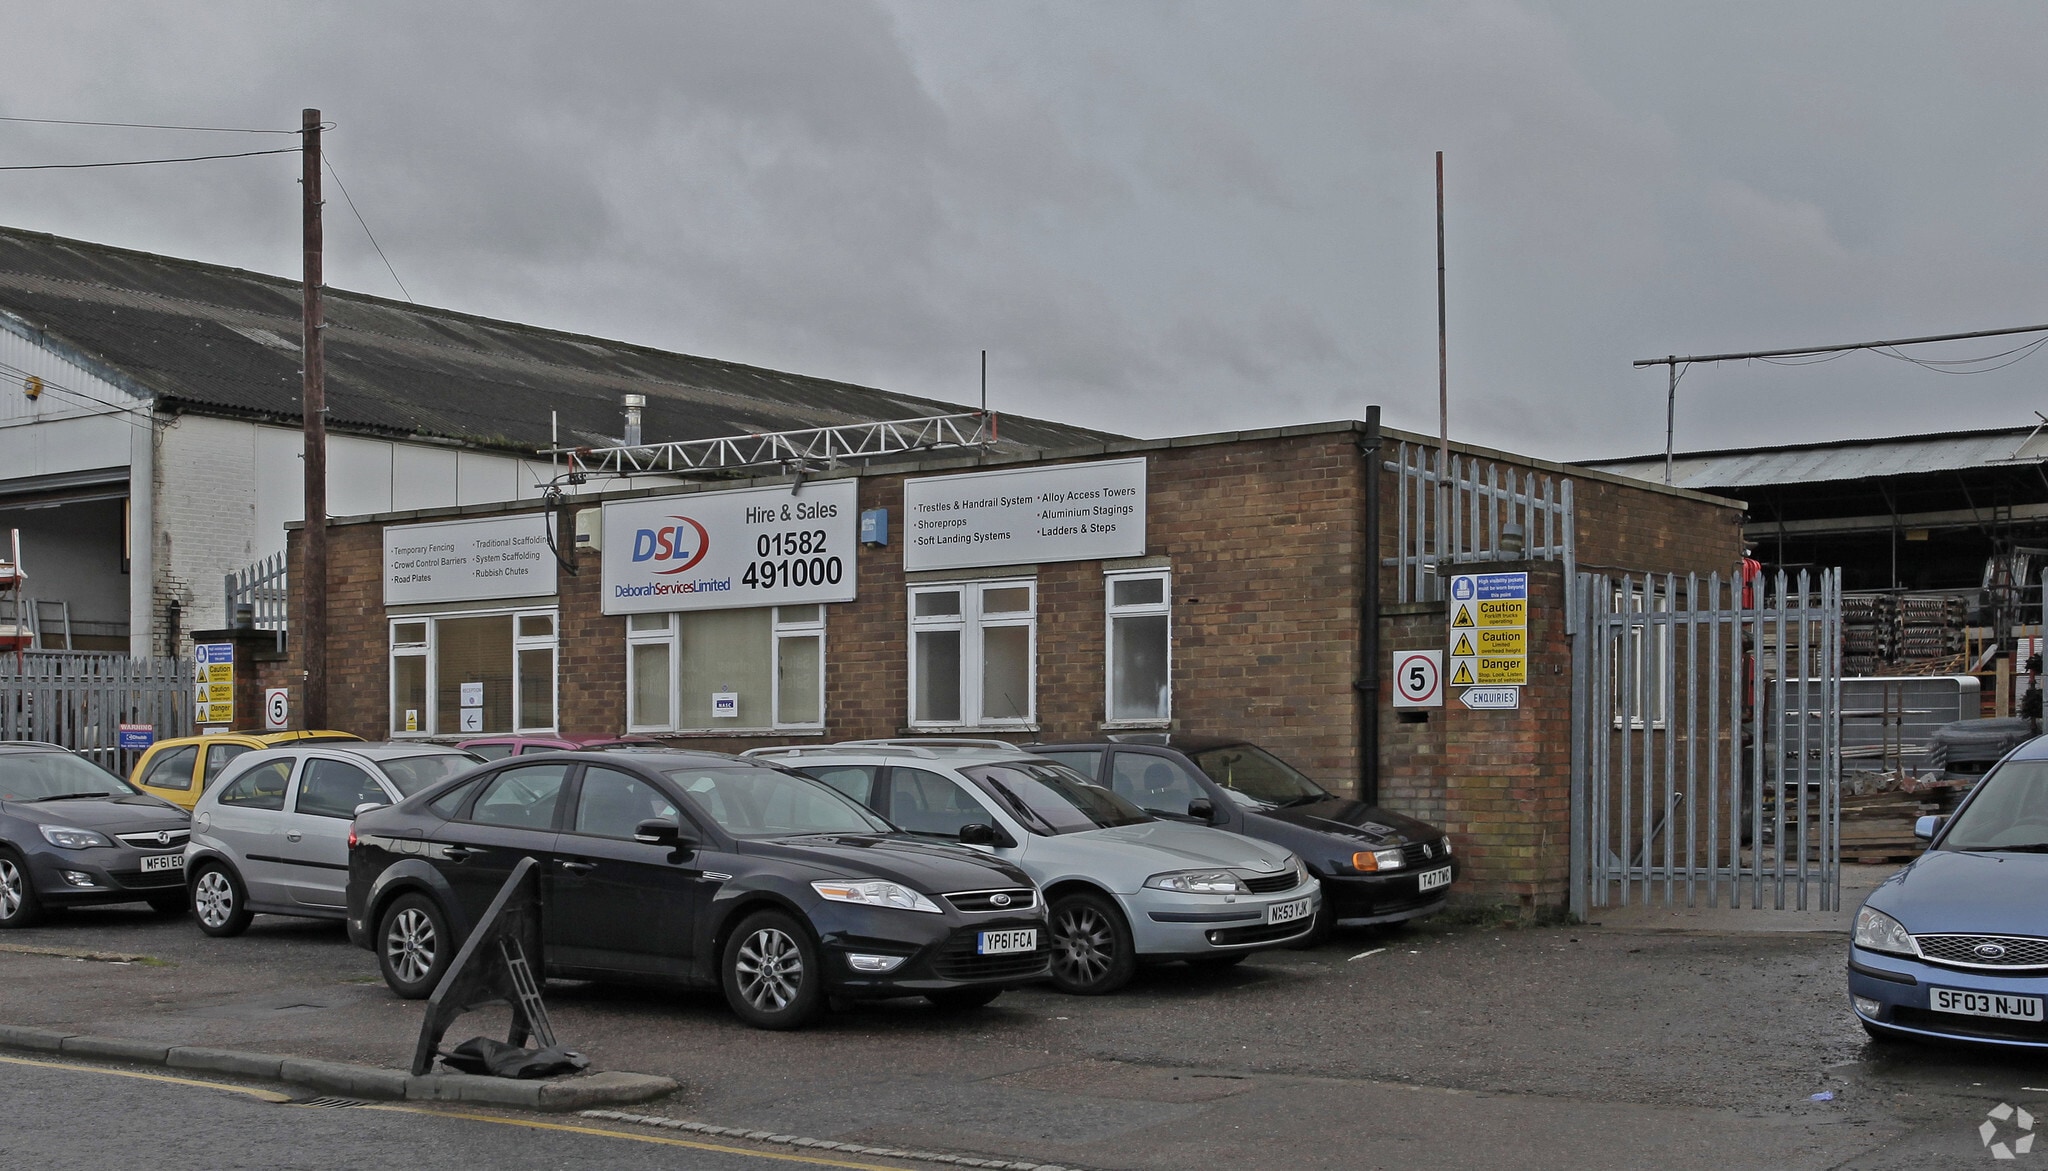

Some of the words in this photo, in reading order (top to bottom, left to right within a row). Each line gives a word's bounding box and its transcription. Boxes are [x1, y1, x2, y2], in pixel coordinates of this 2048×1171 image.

[1042, 492, 1064, 504] Alloy
[1067, 490, 1100, 500] Access
[1103, 487, 1136, 498] Towers
[918, 502, 950, 512] Trestles
[954, 502, 960, 510] &
[962, 498, 998, 510] Handrail
[1000, 496, 1033, 507] System
[746, 507, 776, 524] Hire
[780, 504, 792, 521] &
[796, 502, 838, 520] Sales
[1042, 508, 1090, 520] Aluminium
[1093, 504, 1134, 516] Stagings
[918, 518, 967, 530] Shoreprops
[1042, 526, 1078, 536] Ladders
[1080, 524, 1087, 534] &
[1090, 522, 1116, 534] Steps
[476, 538, 510, 548] Traditional
[632, 526, 690, 562] DSL
[757, 530, 826, 557] 01582
[918, 536, 935, 546] Soft
[937, 534, 972, 544] Landing
[974, 531, 1010, 544] Systems
[394, 547, 428, 556] Temporary
[429, 544, 454, 552] Fencing
[394, 560, 414, 569] Crowd
[416, 559, 440, 568] Control
[441, 558, 466, 566] Barriers
[476, 555, 500, 564] System
[502, 552, 540, 561] Scaffolding
[394, 575, 410, 584] Road
[412, 574, 432, 582] Plates
[476, 568, 503, 578] Rubbish
[506, 567, 528, 576] Chutes
[742, 556, 842, 590] 491000
[1481, 602, 1522, 612] Caution
[1482, 632, 1520, 641] Caution
[1482, 659, 1520, 670] Danger
[1410, 667, 1425, 691] 5
[1474, 693, 1514, 702] ENQUIRIES
[275, 701, 282, 718] 5
[147, 857, 169, 869] MF61
[172, 856, 184, 866] EO
[1423, 872, 1436, 887] T47
[1272, 906, 1294, 921] NX53
[1294, 900, 1308, 917] YJK
[988, 933, 1010, 950] YP61
[1013, 931, 1032, 948] FCA
[1938, 991, 1989, 1012] SF03
[1996, 997, 2035, 1016] NJU
